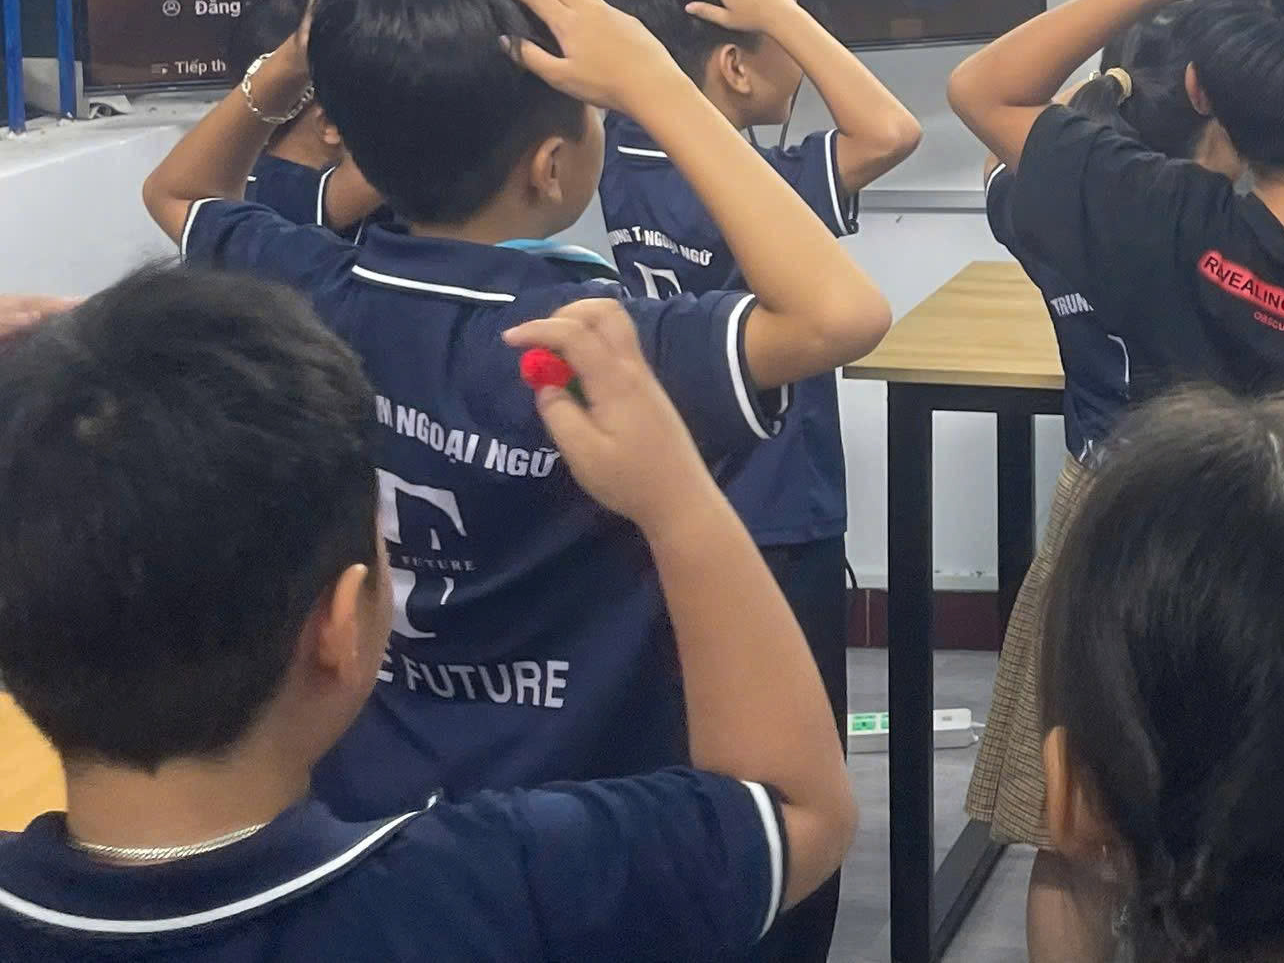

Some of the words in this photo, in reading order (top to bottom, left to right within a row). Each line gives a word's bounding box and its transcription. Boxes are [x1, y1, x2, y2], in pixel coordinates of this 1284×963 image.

[1049, 292, 1094, 317] TRUN
[395, 404, 480, 465] NGOẠI
[400, 652, 570, 709] FUTURE
